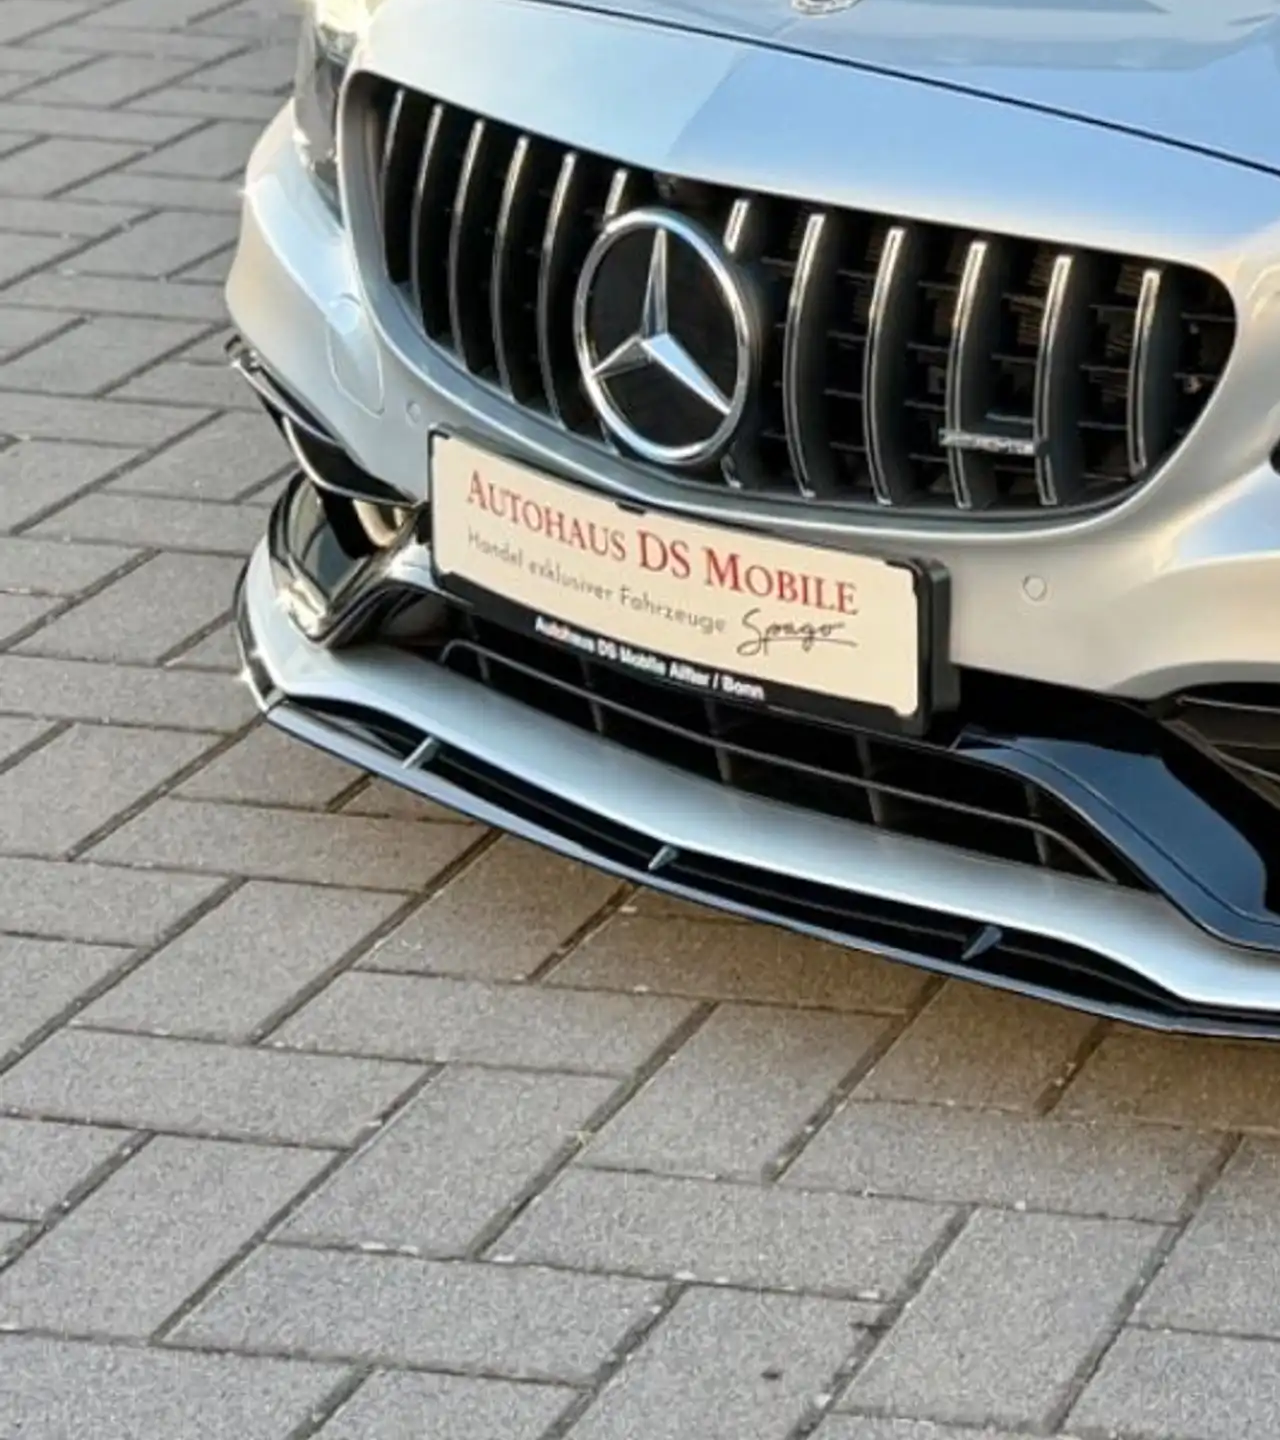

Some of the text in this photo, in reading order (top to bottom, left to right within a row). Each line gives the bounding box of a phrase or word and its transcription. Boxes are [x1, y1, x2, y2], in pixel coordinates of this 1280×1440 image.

[466, 469, 859, 615] AUTOHAUS DS MOBILE
[467, 525, 727, 635] Handel exklusiver Fahrzeuge
[597, 637, 618, 660] DS
[619, 646, 667, 676] Mobile
[721, 674, 766, 701] Bonn
